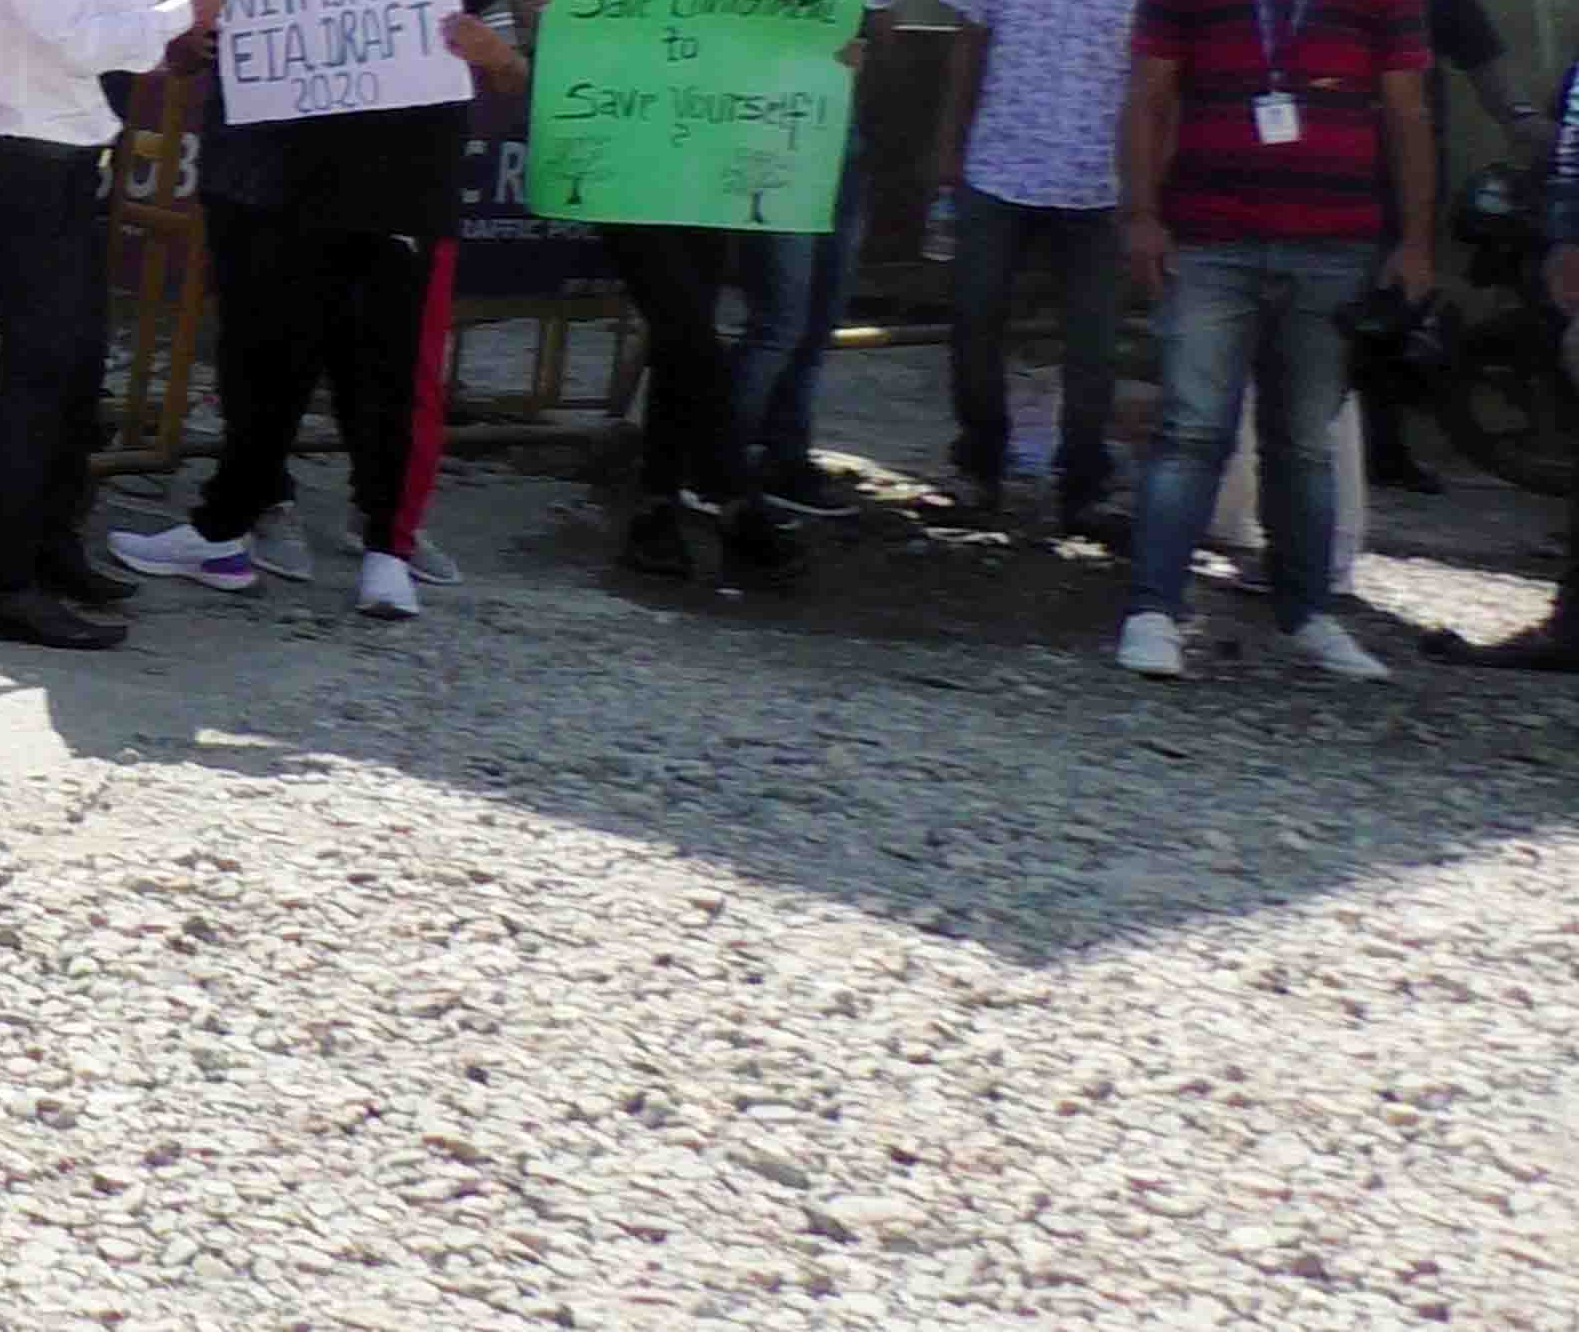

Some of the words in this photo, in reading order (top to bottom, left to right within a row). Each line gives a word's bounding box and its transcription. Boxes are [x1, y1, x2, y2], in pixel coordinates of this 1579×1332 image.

[320, 1, 435, 69] DRAFT
[662, 26, 699, 61] to
[293, 70, 379, 113] 2020
